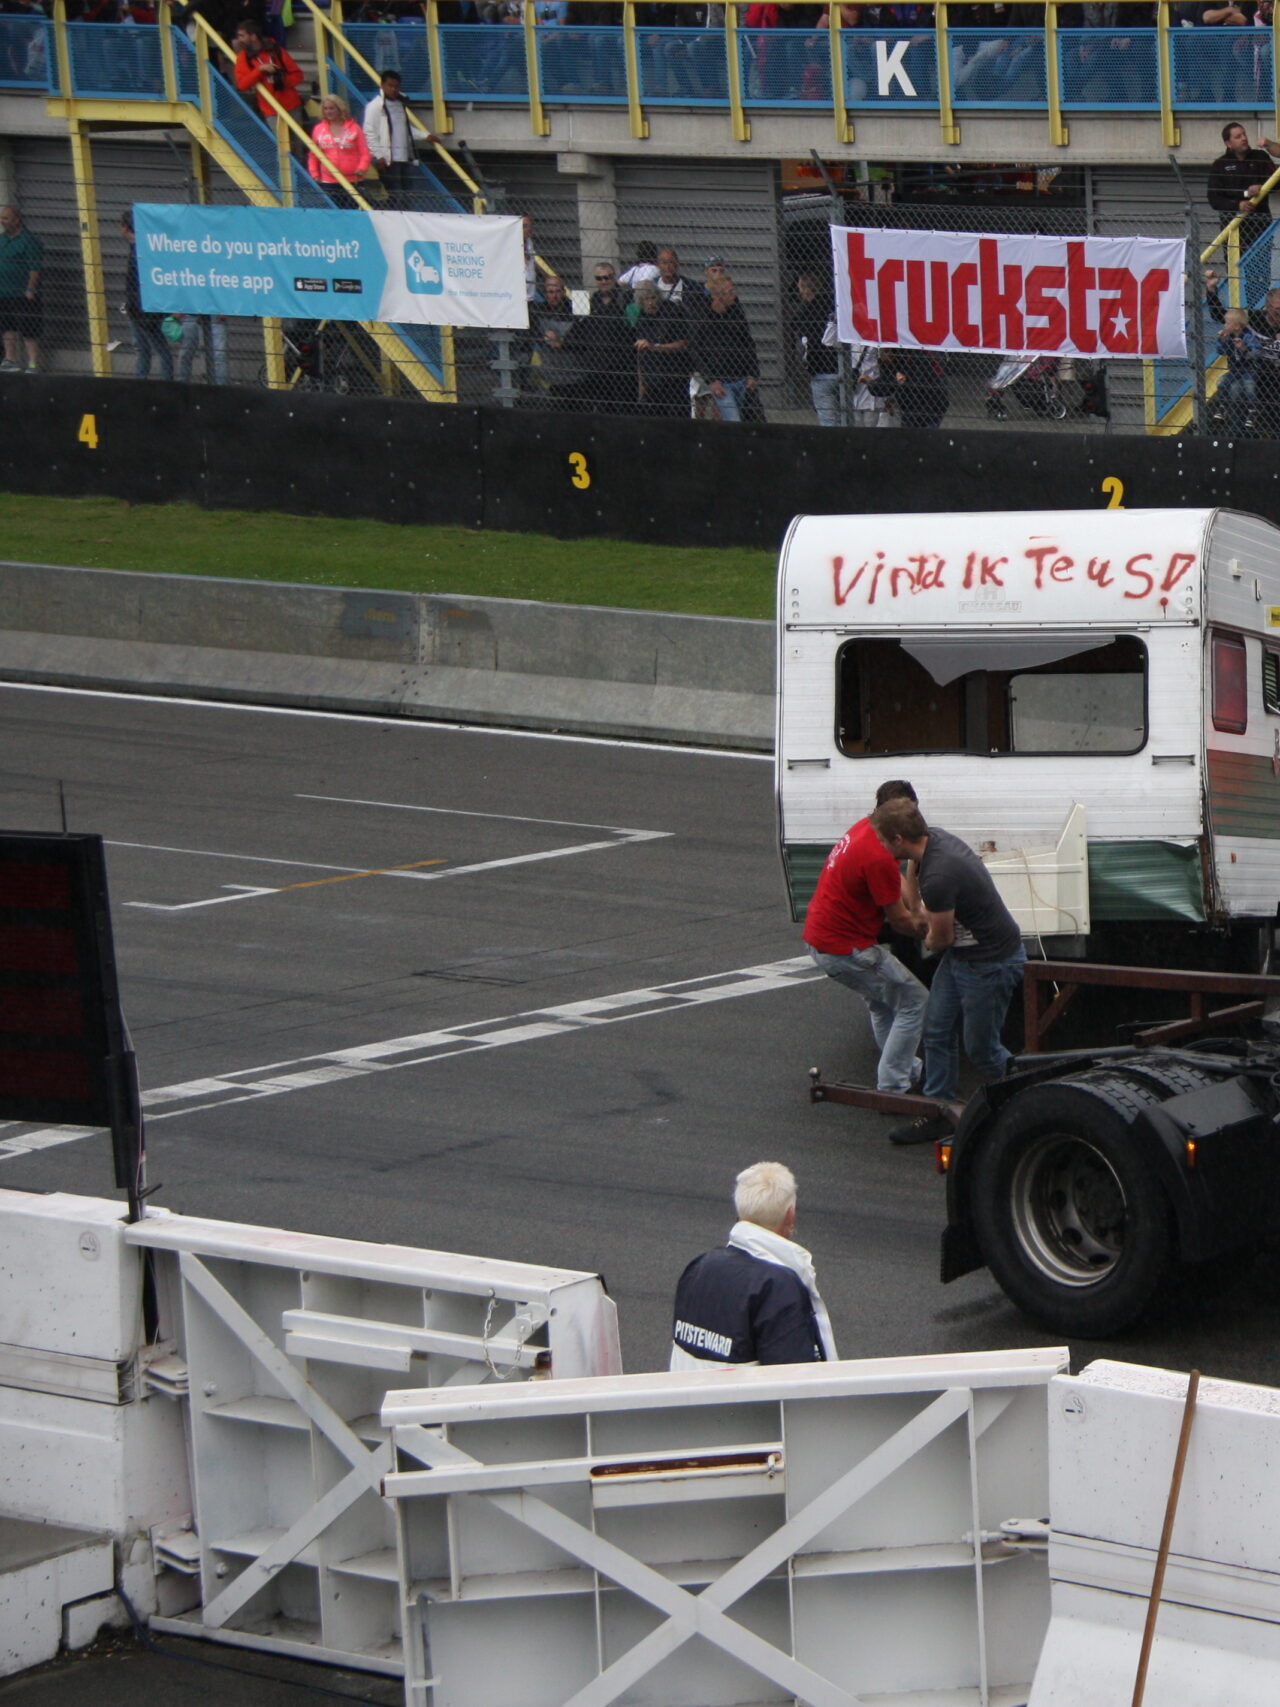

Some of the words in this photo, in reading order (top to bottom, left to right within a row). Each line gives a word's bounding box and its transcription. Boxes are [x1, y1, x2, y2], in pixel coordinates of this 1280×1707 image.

[876, 41, 918, 96] K
[147, 233, 198, 253] Where
[200, 234, 222, 254] do
[225, 241, 253, 260] you
[258, 238, 292, 260] park
[295, 239, 360, 263] tonight?
[444, 242, 474, 253] TRUCK
[446, 255, 485, 266] PARKING
[151, 267, 178, 286] Get
[180, 268, 206, 287] the
[209, 268, 239, 288] free
[243, 275, 274, 294] app
[448, 267, 484, 279] EUROPE
[846, 232, 1170, 354] truckstar
[79, 414, 98, 449] 4
[569, 452, 590, 489] 3
[1102, 476, 1125, 510] 2
[675, 1320, 733, 1357] PITSTEWARD
